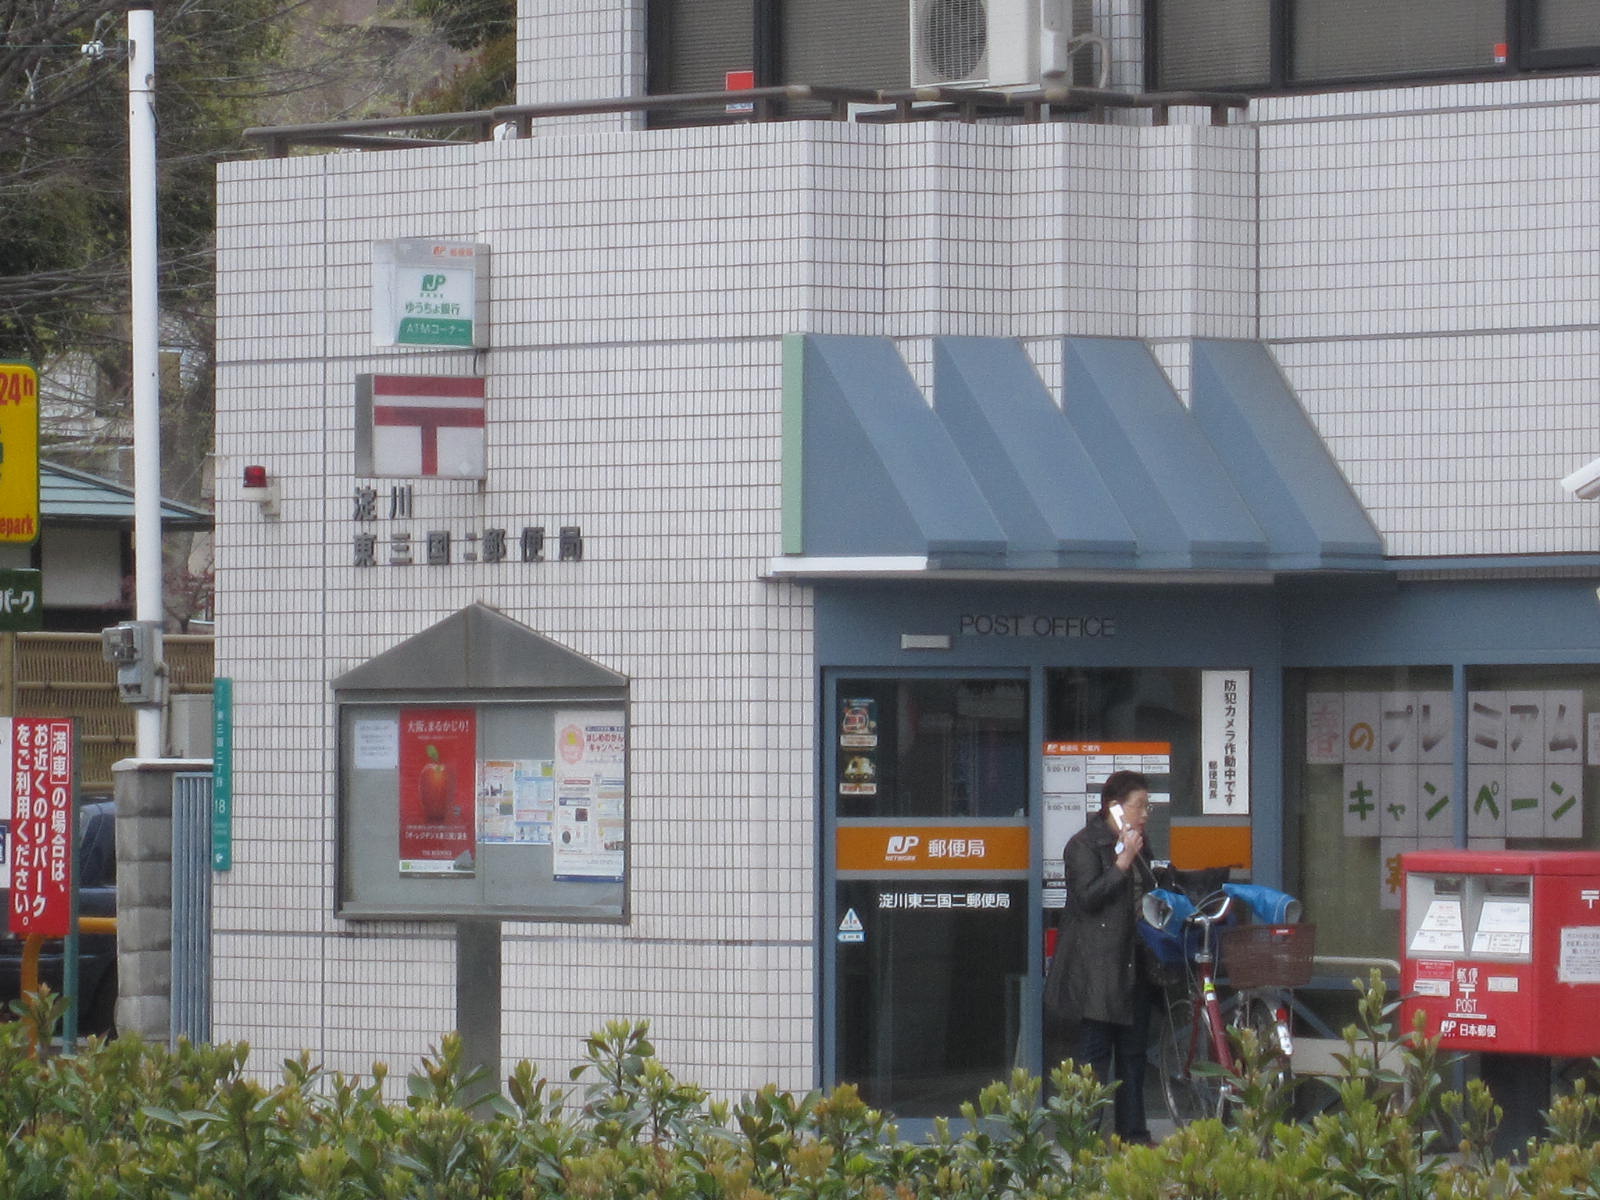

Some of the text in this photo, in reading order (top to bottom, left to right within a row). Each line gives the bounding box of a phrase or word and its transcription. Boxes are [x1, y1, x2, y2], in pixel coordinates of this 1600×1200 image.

[405, 302, 461, 315] ゆうちょ銀行
[406, 323, 465, 335] ATMコーナー
[353, 484, 413, 521] 淀川
[353, 526, 584, 568] 東三国二郵便局
[959, 614, 1116, 638] POST OFFICE
[1224, 679, 1237, 807] 防犯カメラ作動中です
[215, 800, 226, 815] 18
[1348, 780, 1577, 822] キャンペーン
[15, 723, 31, 926] をご利用ください。
[33, 724, 49, 918] お近くのリパーク
[886, 836, 985, 858] JP 郵便局
[879, 893, 1011, 909] 淀川東三国二郵便局
[1456, 967, 1479, 985] 郵便
[1455, 998, 1478, 1013] POST
[1459, 1024, 1497, 1038] 日本郵便
